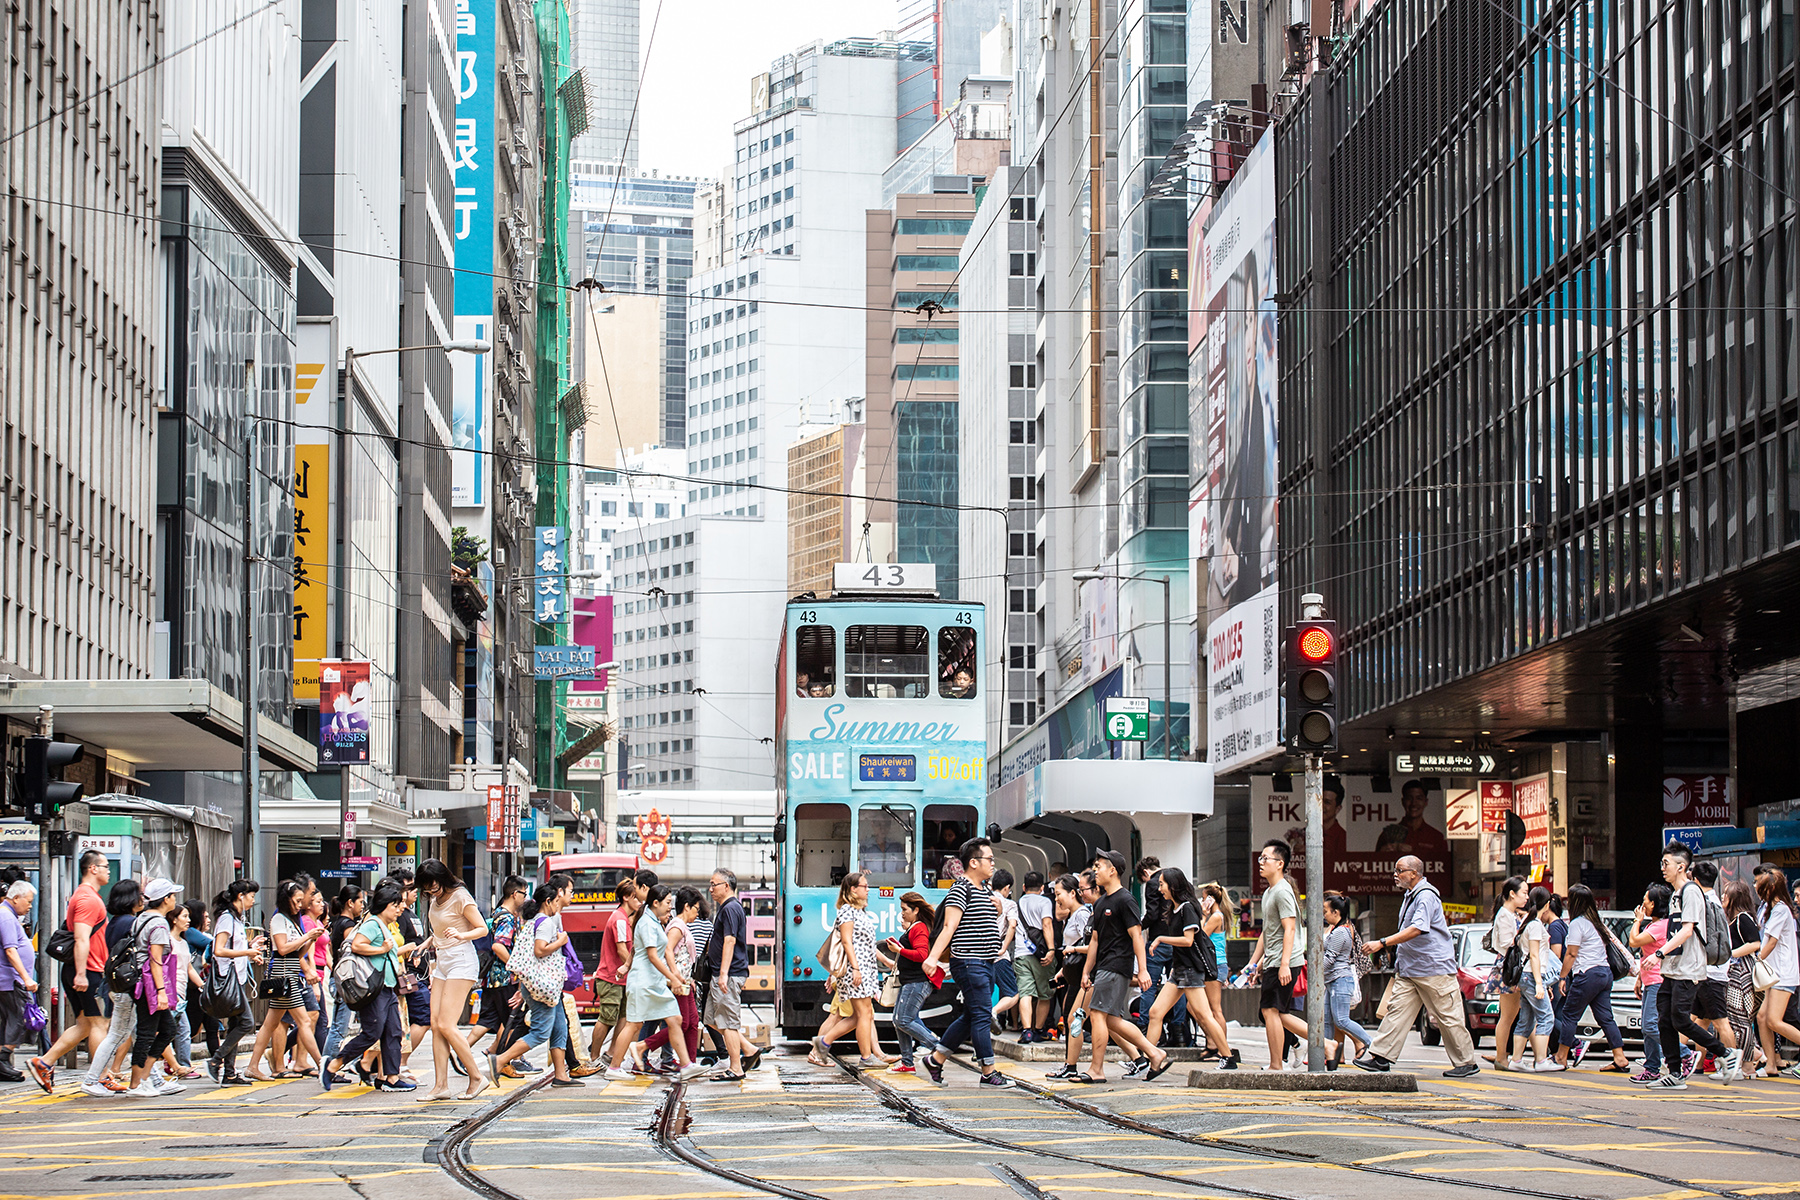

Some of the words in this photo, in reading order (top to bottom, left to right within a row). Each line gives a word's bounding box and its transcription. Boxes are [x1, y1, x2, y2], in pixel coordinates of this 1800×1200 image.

[537, 528, 562, 622] 日發文具
[862, 565, 905, 587] 43
[800, 610, 817, 623] 43
[955, 612, 972, 625] 43
[537, 651, 563, 663] YAT
[569, 651, 592, 663] FAT
[809, 703, 960, 742] Summer
[324, 733, 367, 742] HORSES
[791, 752, 845, 780] SALE
[860, 757, 914, 767] Shaukeiwan
[1268, 803, 1302, 822] HK
[1352, 803, 1398, 822] PHL
[82, 840, 115, 848] 公共電話
[880, 889, 894, 897] 107
